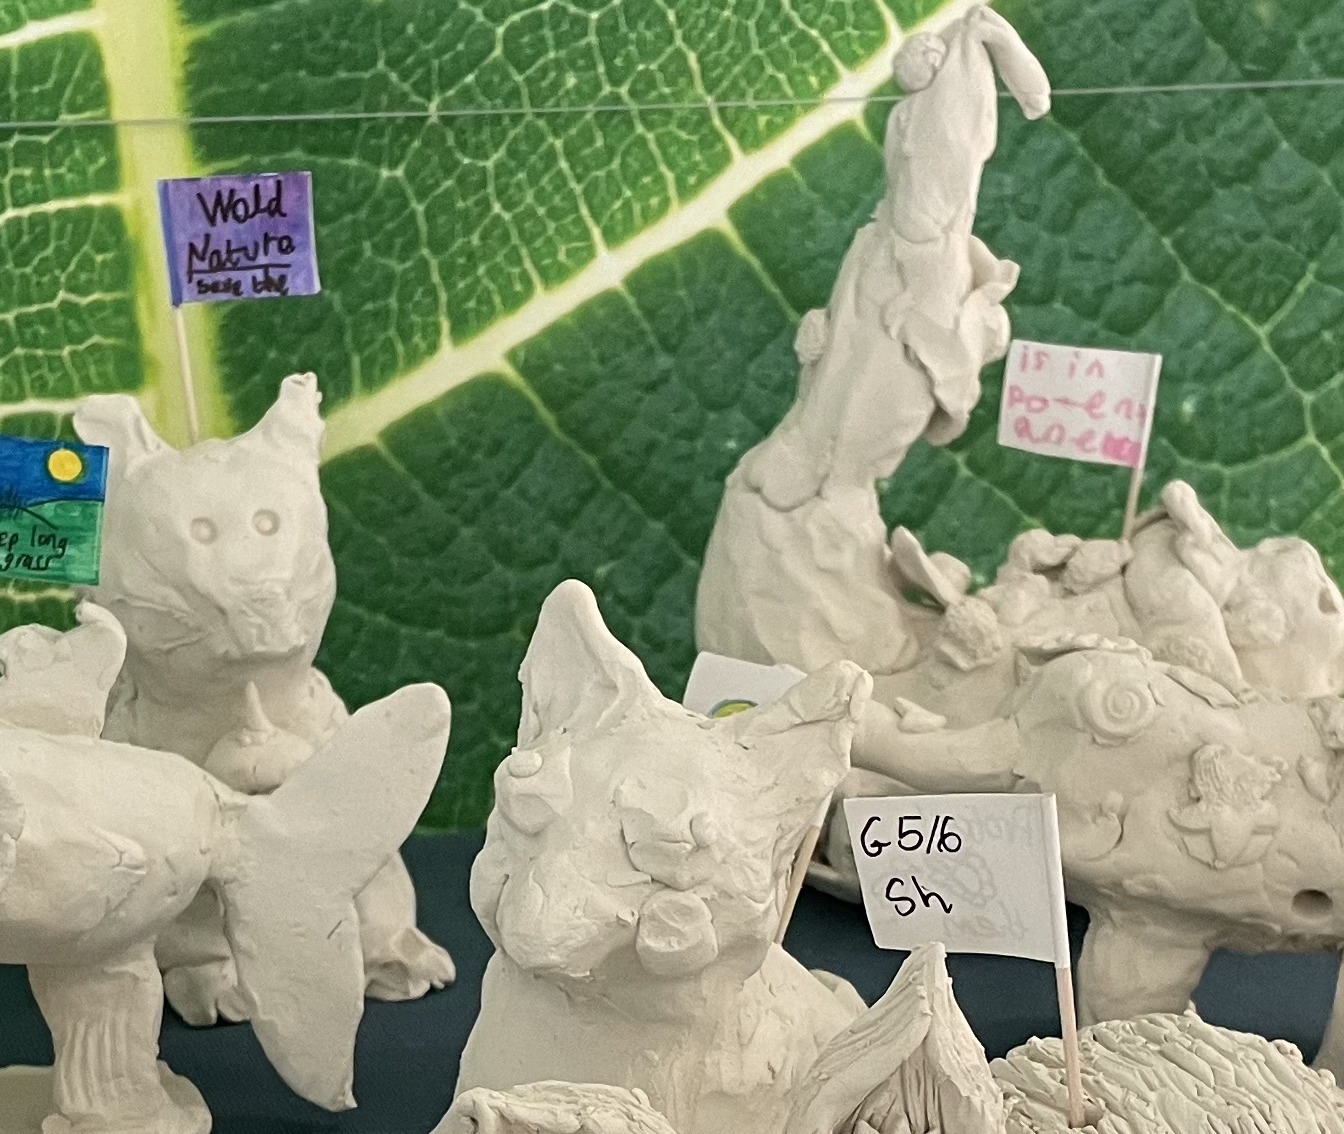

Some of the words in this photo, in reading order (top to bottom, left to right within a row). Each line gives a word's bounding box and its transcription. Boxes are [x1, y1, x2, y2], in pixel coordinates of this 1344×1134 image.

[1068, 350, 1104, 378] in
[31, 525, 68, 559] long
[0, 551, 63, 572] grass
